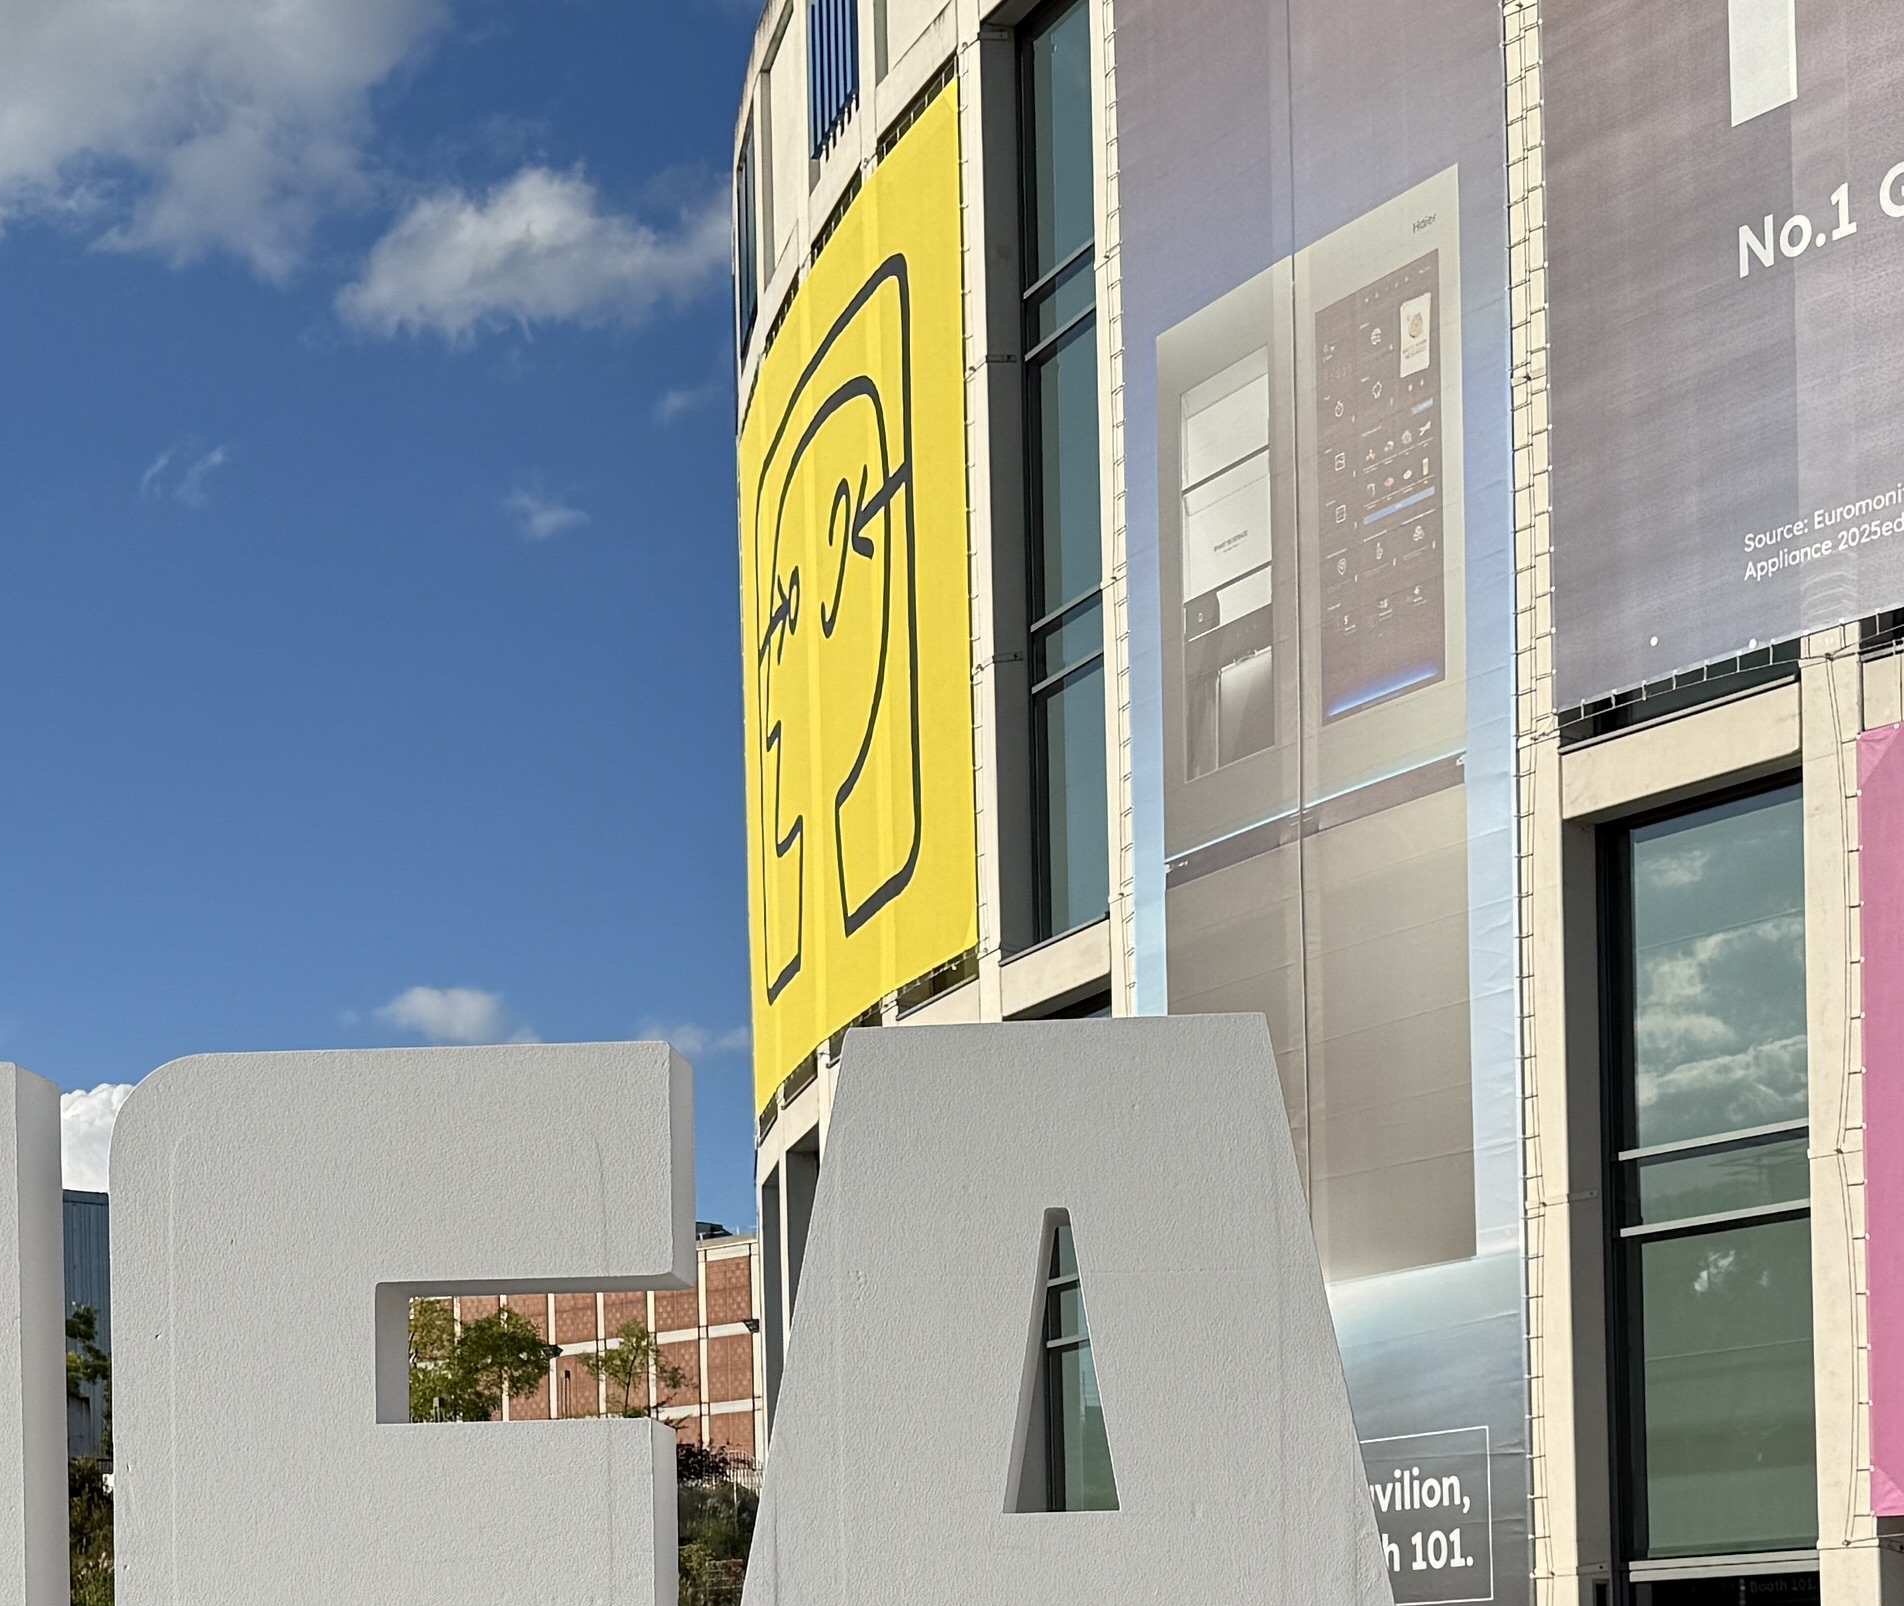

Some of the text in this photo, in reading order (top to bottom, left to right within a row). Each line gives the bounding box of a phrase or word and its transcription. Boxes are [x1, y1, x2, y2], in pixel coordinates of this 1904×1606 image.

[1738, 182, 1857, 279] No.1
[1744, 519, 1808, 552] Source:
[1744, 538, 1832, 581] Appliance
[1369, 1466, 1471, 1514] vilion,
[1411, 1527, 1474, 1571] 101.
